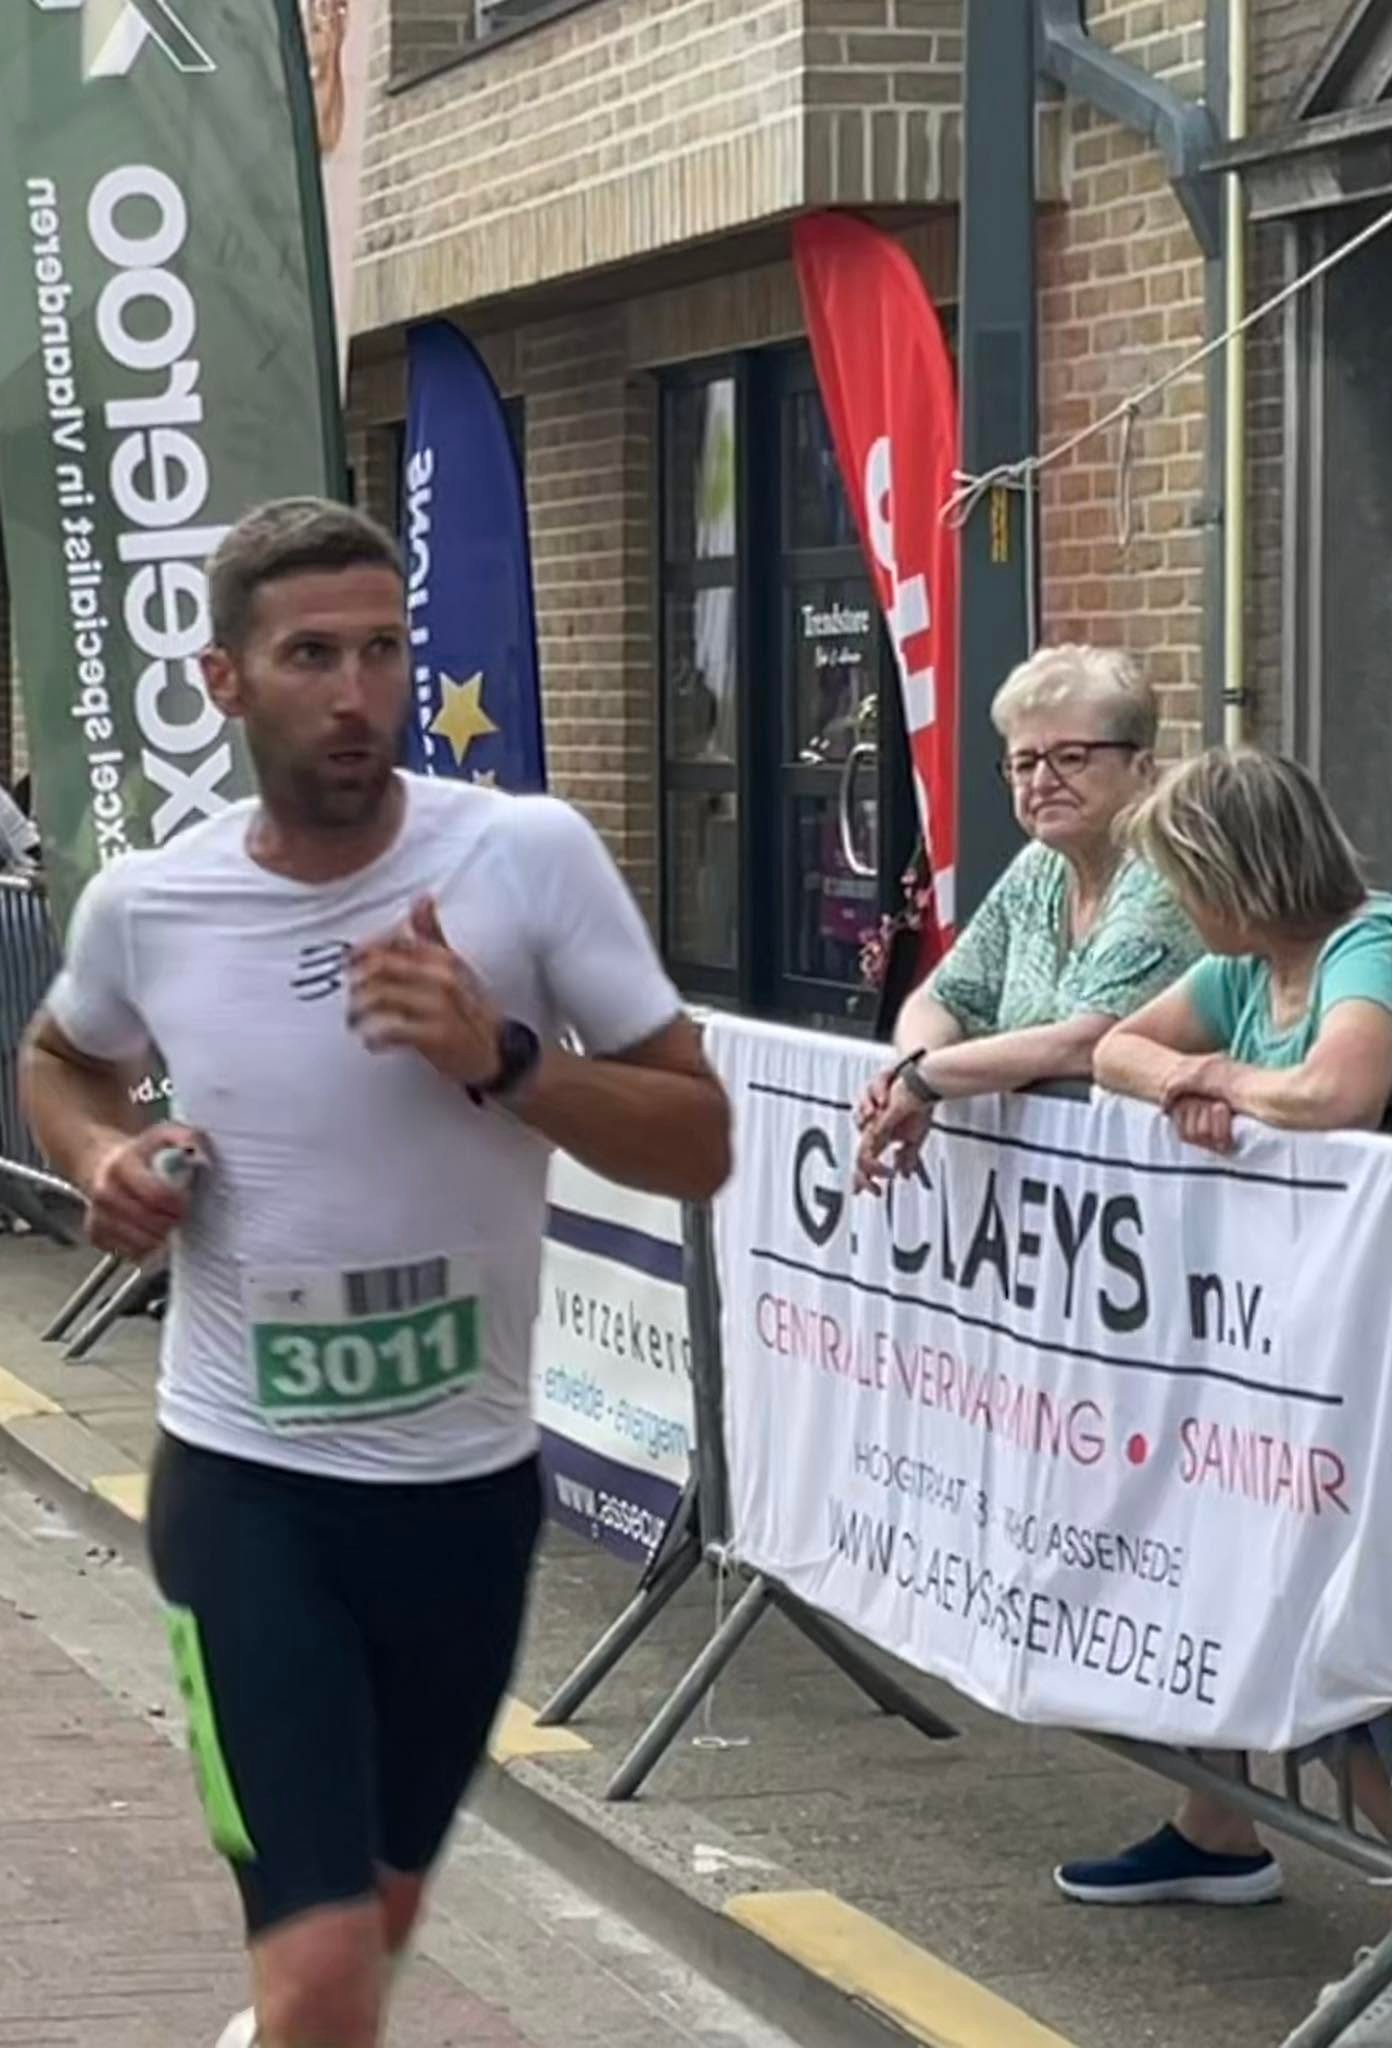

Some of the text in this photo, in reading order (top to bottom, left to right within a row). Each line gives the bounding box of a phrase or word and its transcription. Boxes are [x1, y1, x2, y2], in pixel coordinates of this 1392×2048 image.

[886, 1150, 1151, 1333] CLAEYS
[1187, 1273, 1271, 1355] n.v.
[270, 1311, 459, 1397] 3011
[1180, 1417, 1350, 1515] SANITAIR
[1045, 1521, 1183, 1588] ASSENEDE
